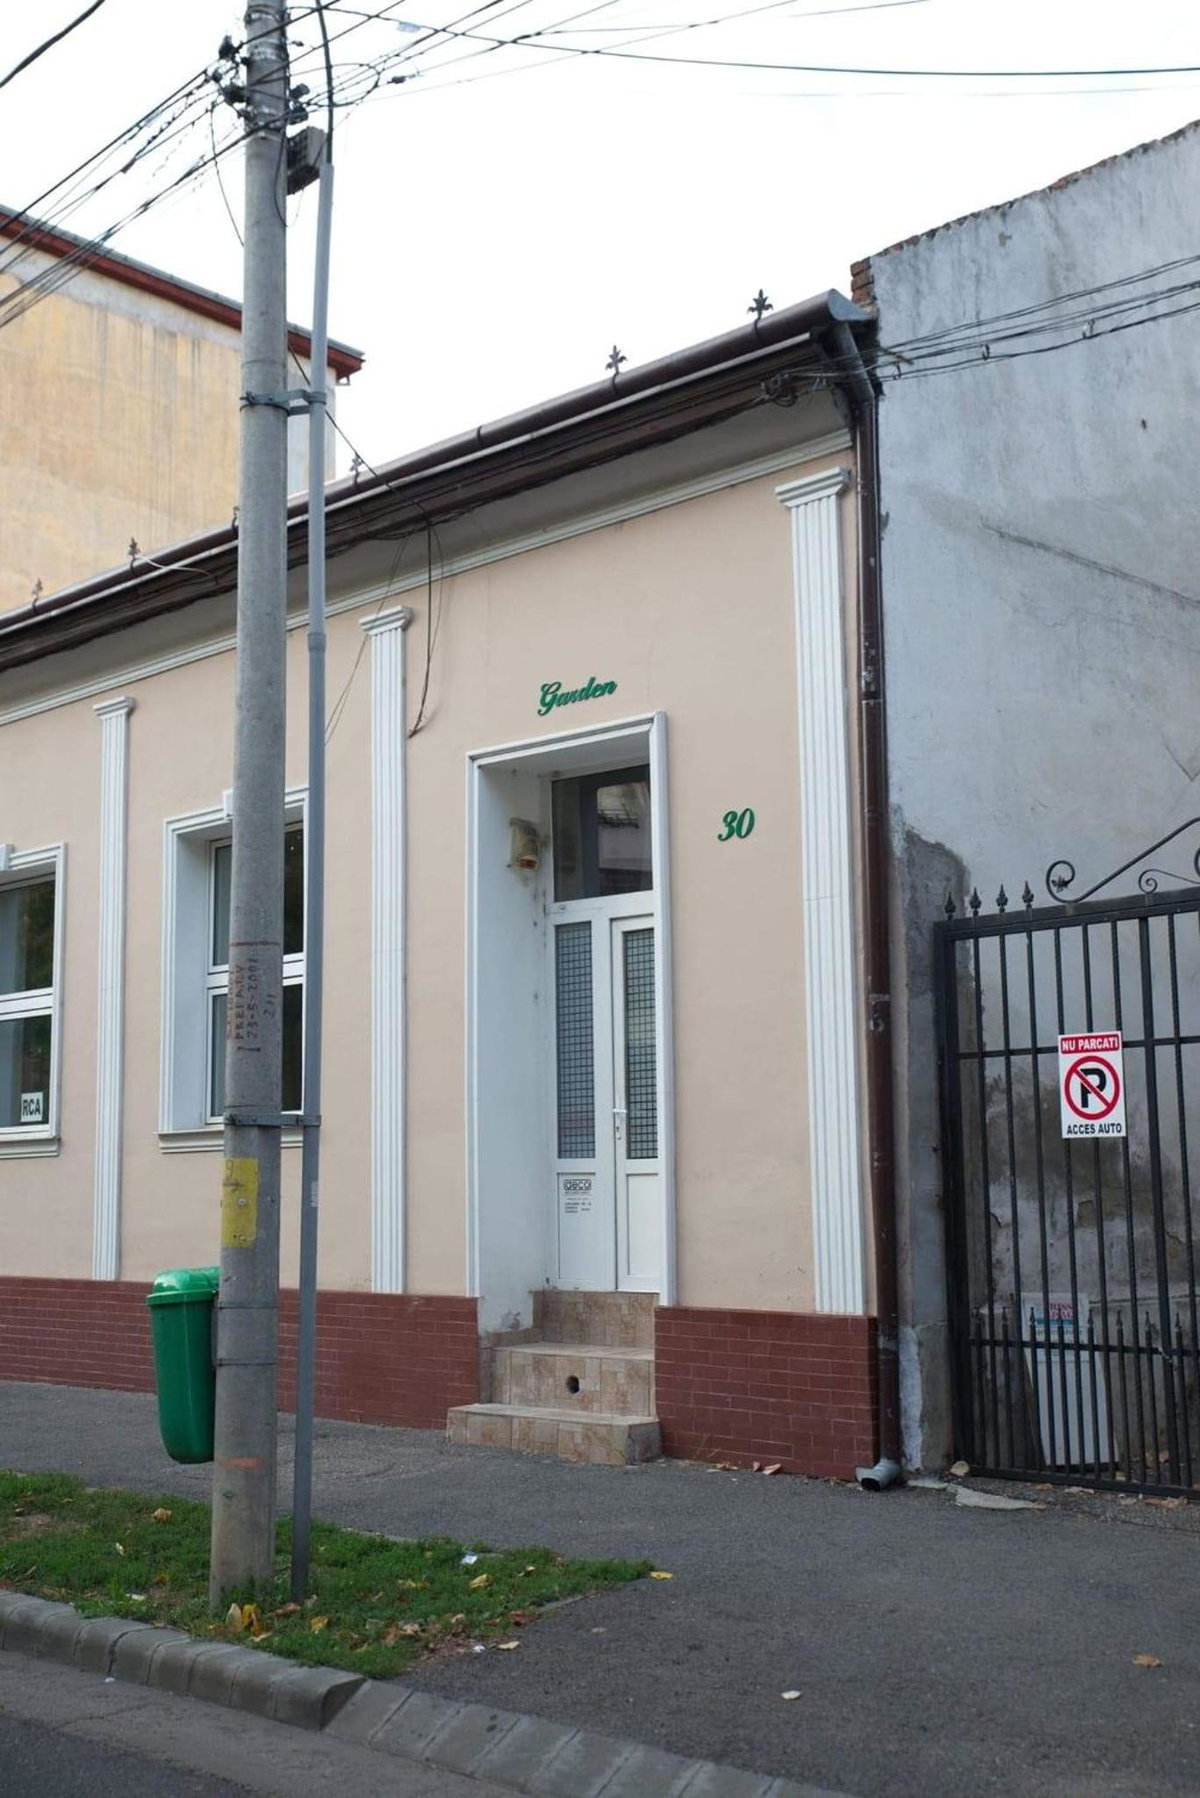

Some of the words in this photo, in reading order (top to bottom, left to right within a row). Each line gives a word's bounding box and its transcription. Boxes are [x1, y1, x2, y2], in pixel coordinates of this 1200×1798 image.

[538, 676, 617, 716] Garden
[718, 808, 755, 842] 30
[1062, 1039, 1075, 1051] NU
[1078, 1037, 1118, 1050] PARCATI
[1080, 1068, 1107, 1108] P
[22, 1098, 41, 1117] RCA
[1066, 1123, 1096, 1135] ACCES
[1098, 1122, 1122, 1134] AUTO
